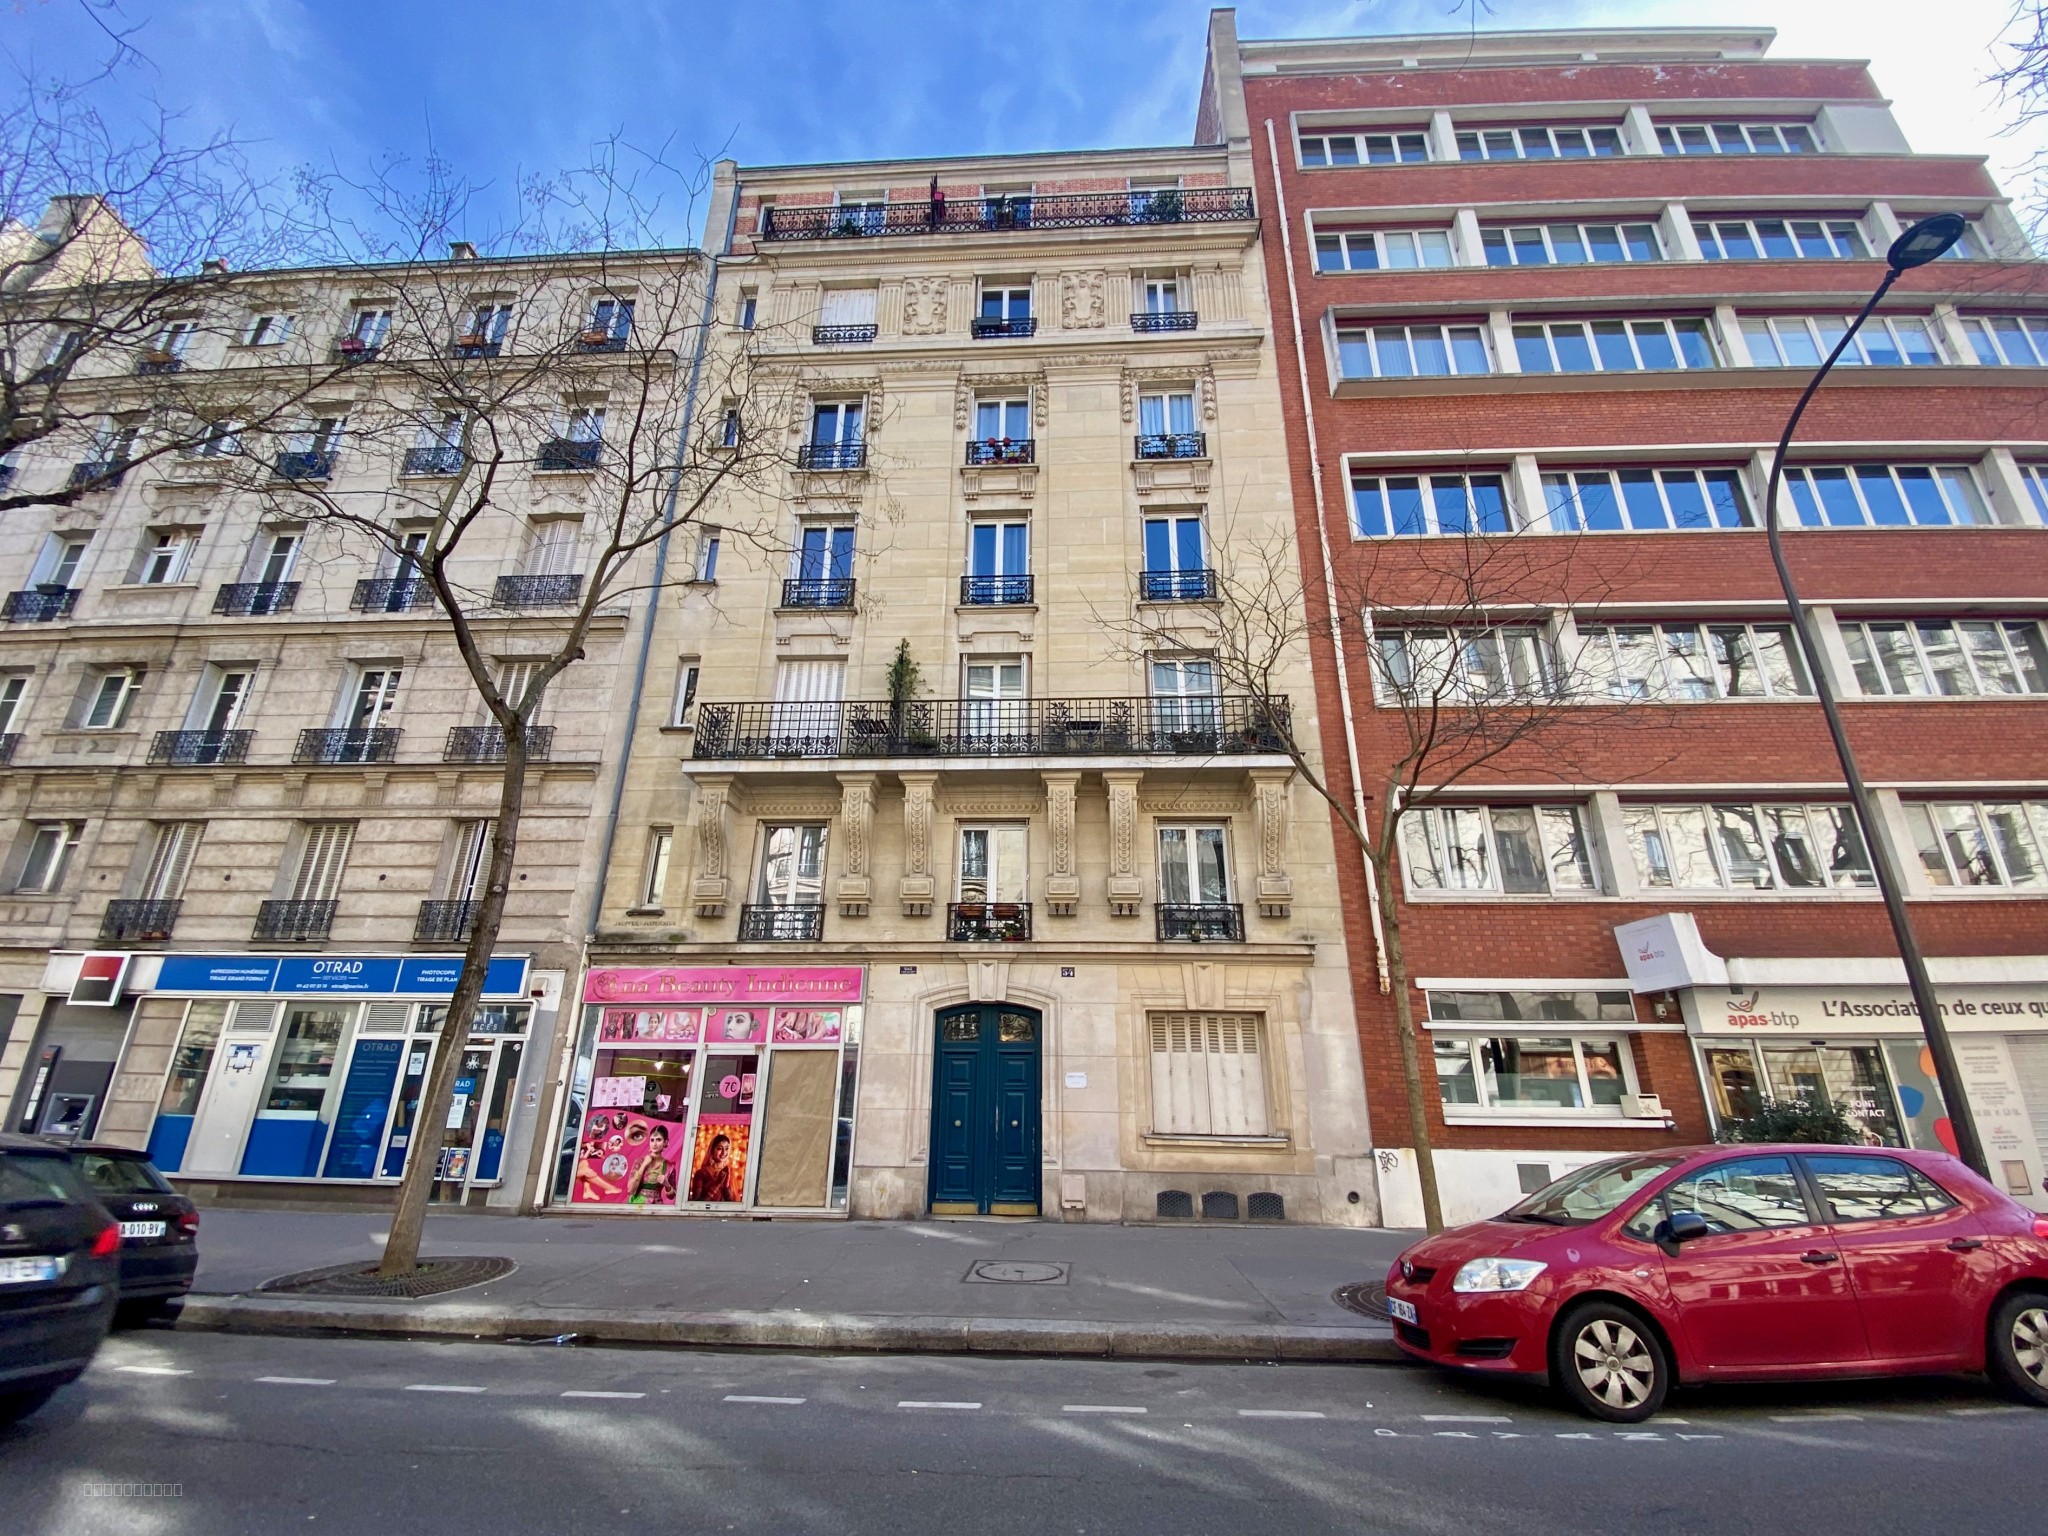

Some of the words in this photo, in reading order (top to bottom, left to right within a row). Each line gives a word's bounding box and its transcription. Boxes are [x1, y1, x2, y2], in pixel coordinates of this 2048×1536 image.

[313, 961, 363, 973] OTRAD
[657, 974, 740, 999] Beauty
[745, 973, 851, 993] Indienne
[1822, 1000, 1949, 1017] L'Associatn
[1953, 999, 1977, 1016] de
[1981, 1002, 2025, 1015] ceux
[1728, 1011, 1800, 1029] apas-btp
[362, 1043, 398, 1052] OTRAD
[724, 1081, 737, 1093] 7€
[1850, 1100, 1876, 1108] POINT
[1845, 1109, 1886, 1118] CONTACT
[121, 1223, 159, 1235] A-010-BV
